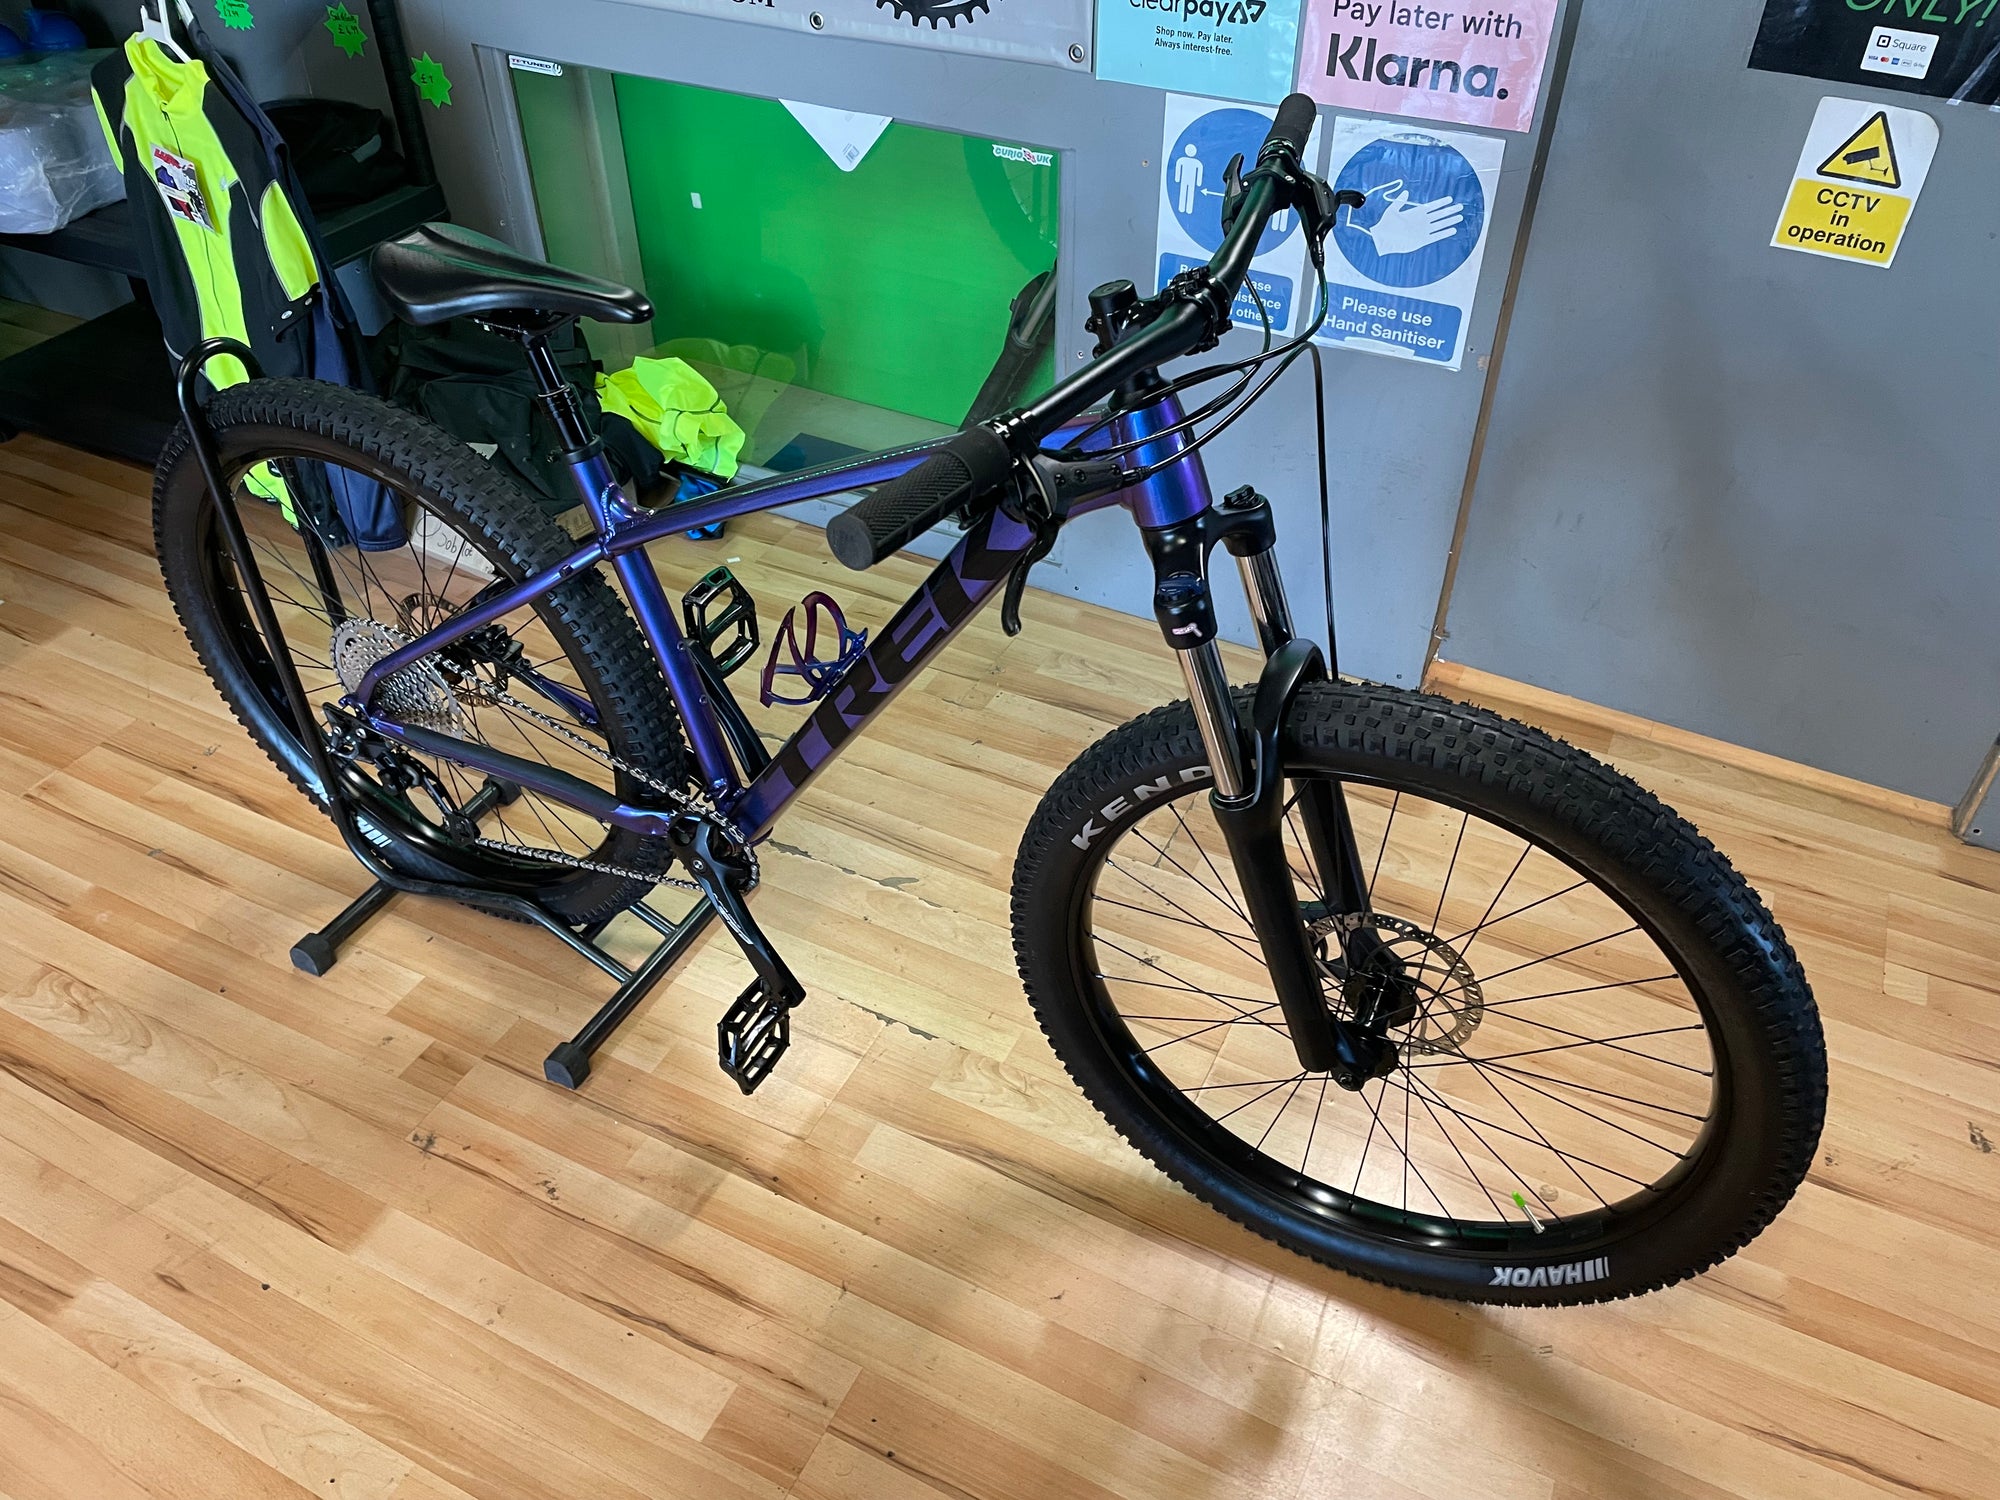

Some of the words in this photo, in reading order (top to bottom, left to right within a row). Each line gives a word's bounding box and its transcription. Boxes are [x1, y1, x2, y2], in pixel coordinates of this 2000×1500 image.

[1333, 0, 1382, 27] Pay
[1389, 0, 1454, 30] later
[1462, 11, 1522, 39] with
[1154, 38, 1181, 50] Always
[1182, 41, 1233, 56] interest-free.
[1156, 25, 1175, 38] Shop
[1177, 30, 1195, 39] now.
[1197, 31, 1211, 42] Pay
[1213, 33, 1233, 44] later.
[1892, 38, 1927, 53] Square
[1325, 33, 1508, 100] Klarna.
[1816, 188, 1881, 213] CCTV
[1830, 210, 1850, 227] in
[1787, 225, 1886, 254] operation
[1242, 280, 1272, 292] ase
[1236, 309, 1274, 324] othes
[1341, 296, 1397, 320] Please
[1401, 311, 1432, 326] use
[1323, 314, 1367, 334] Hand
[1370, 323, 1446, 350] Sanitiser
[762, 502, 1028, 790] TREK
[1070, 765, 1213, 851] KEND
[1488, 1261, 1584, 1288] HAVOK
